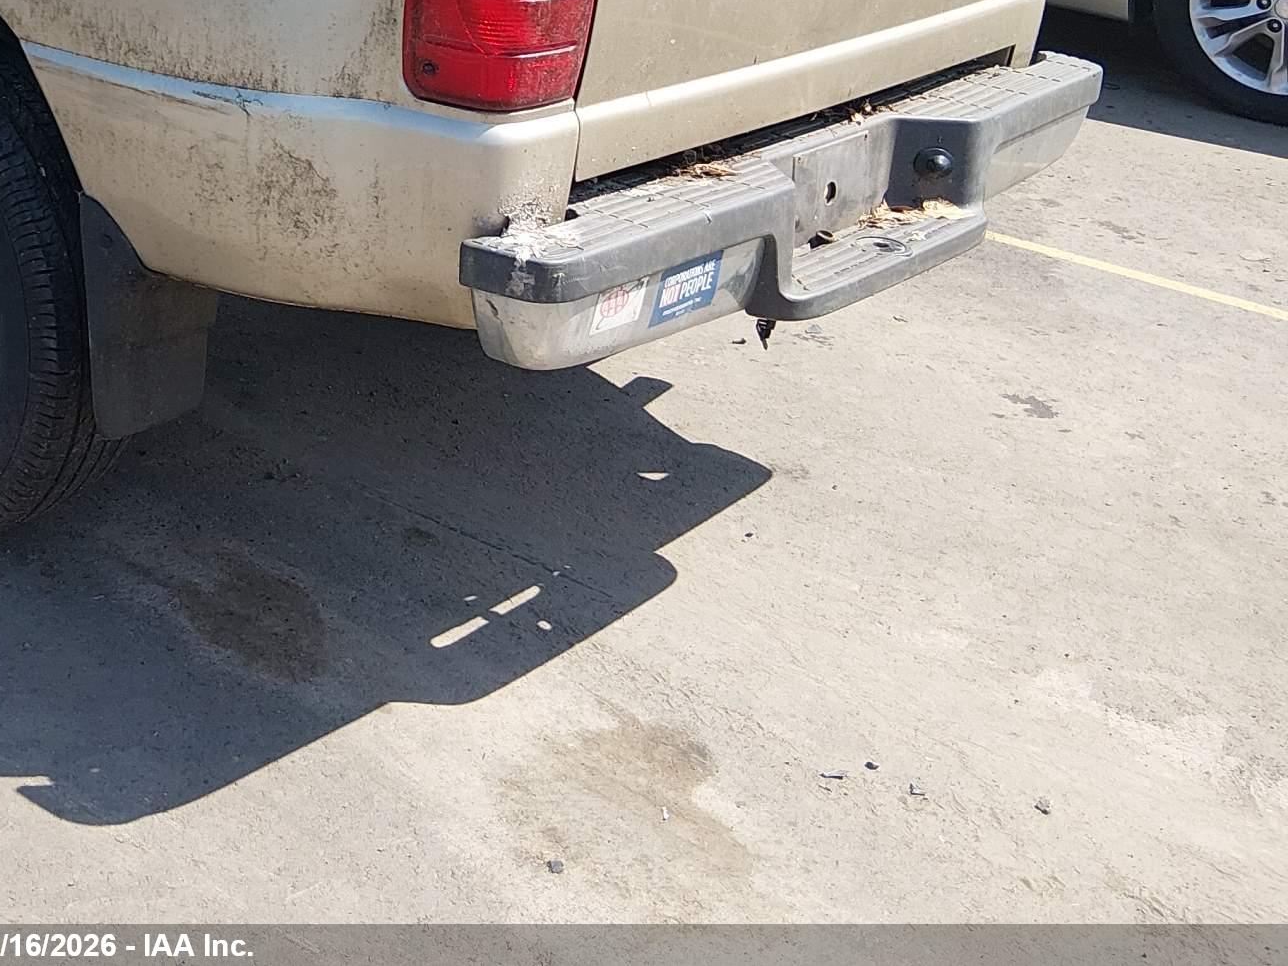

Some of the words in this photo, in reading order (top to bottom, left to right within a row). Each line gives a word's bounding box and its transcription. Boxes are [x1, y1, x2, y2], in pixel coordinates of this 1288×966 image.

[658, 283, 682, 309] NOT
[679, 271, 715, 300] PEOPLE
[664, 264, 704, 288] CORPORATIONS
[703, 258, 717, 273] ARE
